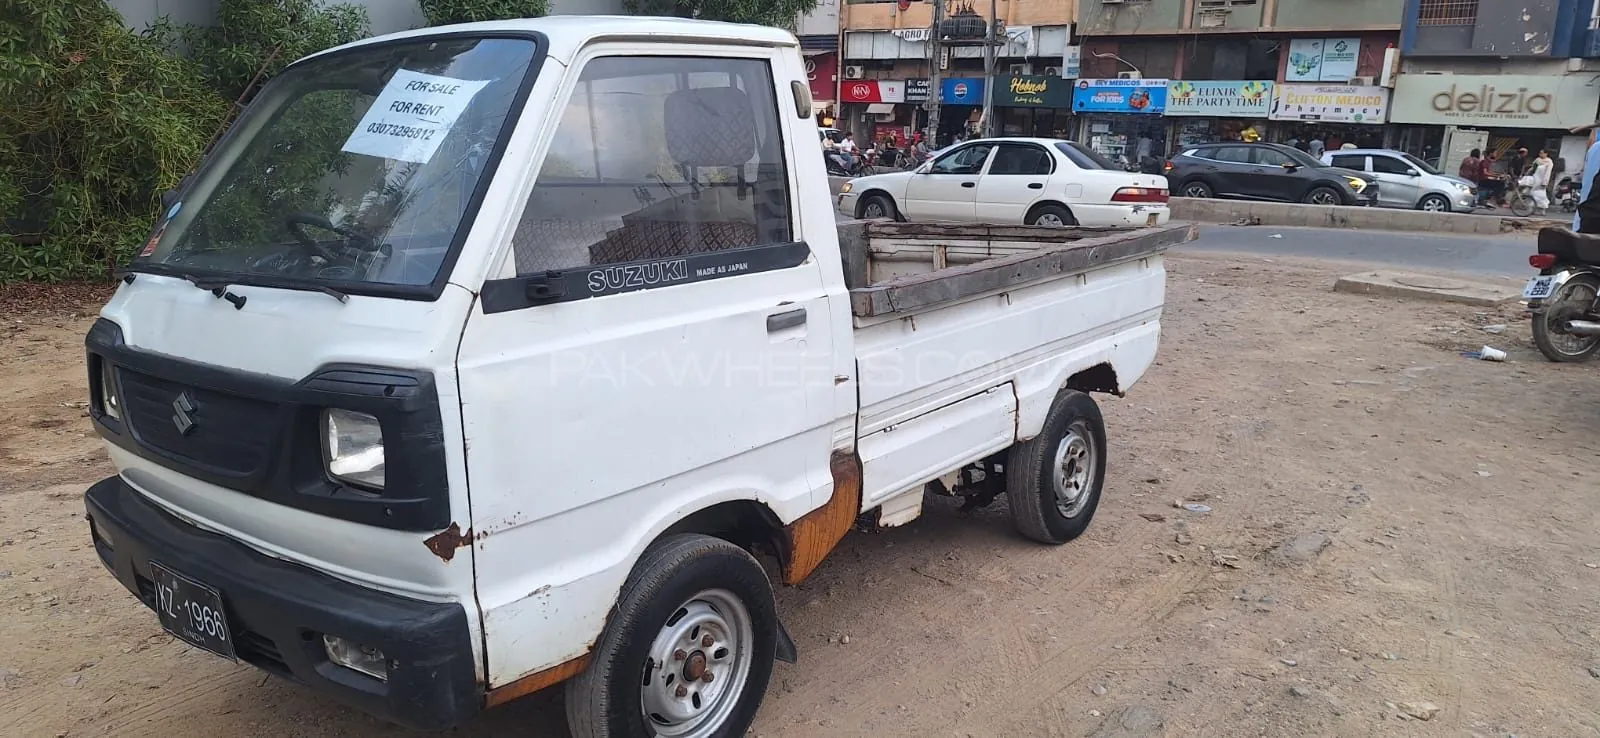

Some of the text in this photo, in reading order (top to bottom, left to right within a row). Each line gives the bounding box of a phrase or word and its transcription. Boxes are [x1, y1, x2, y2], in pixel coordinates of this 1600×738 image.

[404, 80, 460, 95] FOR SALE
[1198, 87, 1237, 97] ELIXIR
[1172, 97, 1265, 107] THE PARTY TIME
[1432, 83, 1552, 114] delizia
[389, 100, 445, 116] FOR RENT
[366, 122, 436, 141] 03073295812
[587, 259, 749, 292] SUZUKI MADE AS JAPAN
[183, 628, 206, 642] SINDH
